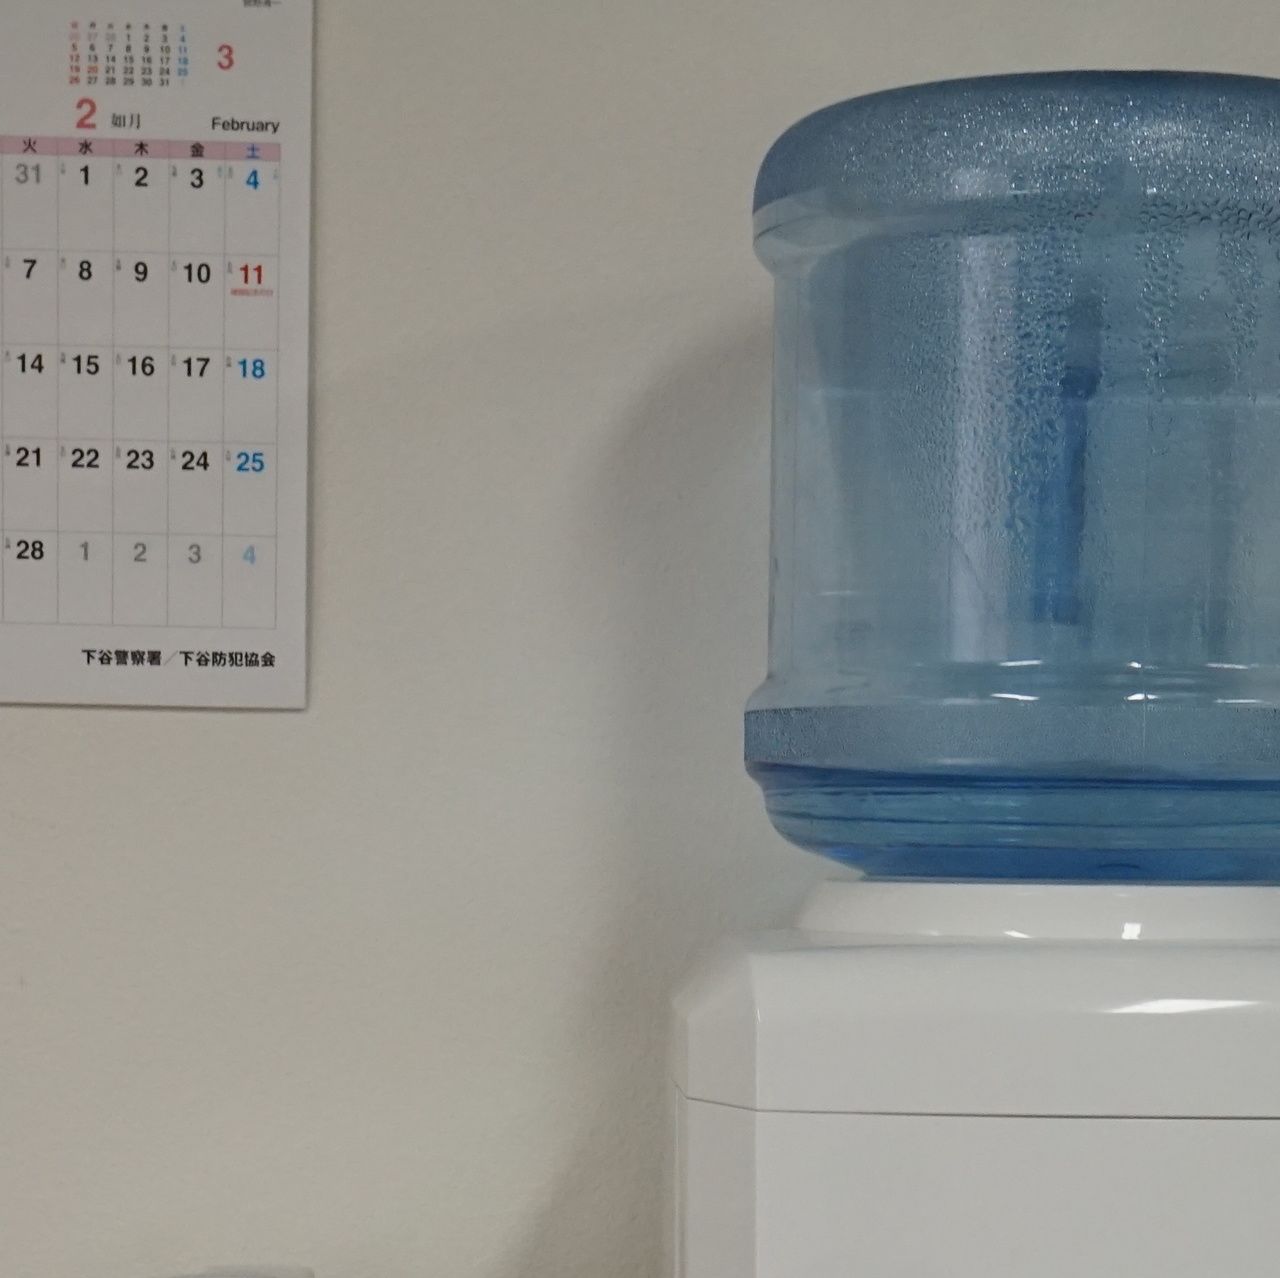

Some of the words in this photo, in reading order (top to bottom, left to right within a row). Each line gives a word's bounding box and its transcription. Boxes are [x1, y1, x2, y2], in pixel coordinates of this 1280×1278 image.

[218, 44, 234, 70] 3
[76, 98, 96, 129] 2
[112, 114, 140, 129] 如月
[212, 117, 279, 133] February
[22, 139, 37, 153] 火
[78, 141, 93, 155] 水
[134, 142, 149, 156] 木
[190, 143, 205, 157] 金
[245, 145, 260, 159] 土
[15, 164, 41, 184] 31
[80, 165, 89, 185] 1
[134, 167, 149, 187] 2
[190, 168, 204, 188] 3
[246, 170, 260, 189] 4
[23, 259, 37, 279] 7
[78, 261, 93, 280] 8
[134, 262, 149, 282] 9
[184, 263, 211, 283] 10
[239, 265, 263, 284] 11
[17, 354, 44, 373] 14
[73, 355, 100, 375] 15
[128, 356, 155, 376] 16
[183, 358, 211, 377] 17
[238, 359, 266, 378] 18
[16, 447, 41, 466] 21
[71, 449, 100, 468] 22
[126, 450, 155, 469] 23
[181, 451, 210, 470] 24
[236, 452, 265, 472] 25
[16, 540, 45, 560] 28
[80, 542, 89, 560] 1
[133, 543, 147, 562] 2
[188, 544, 202, 564] 3
[242, 546, 256, 564] 4
